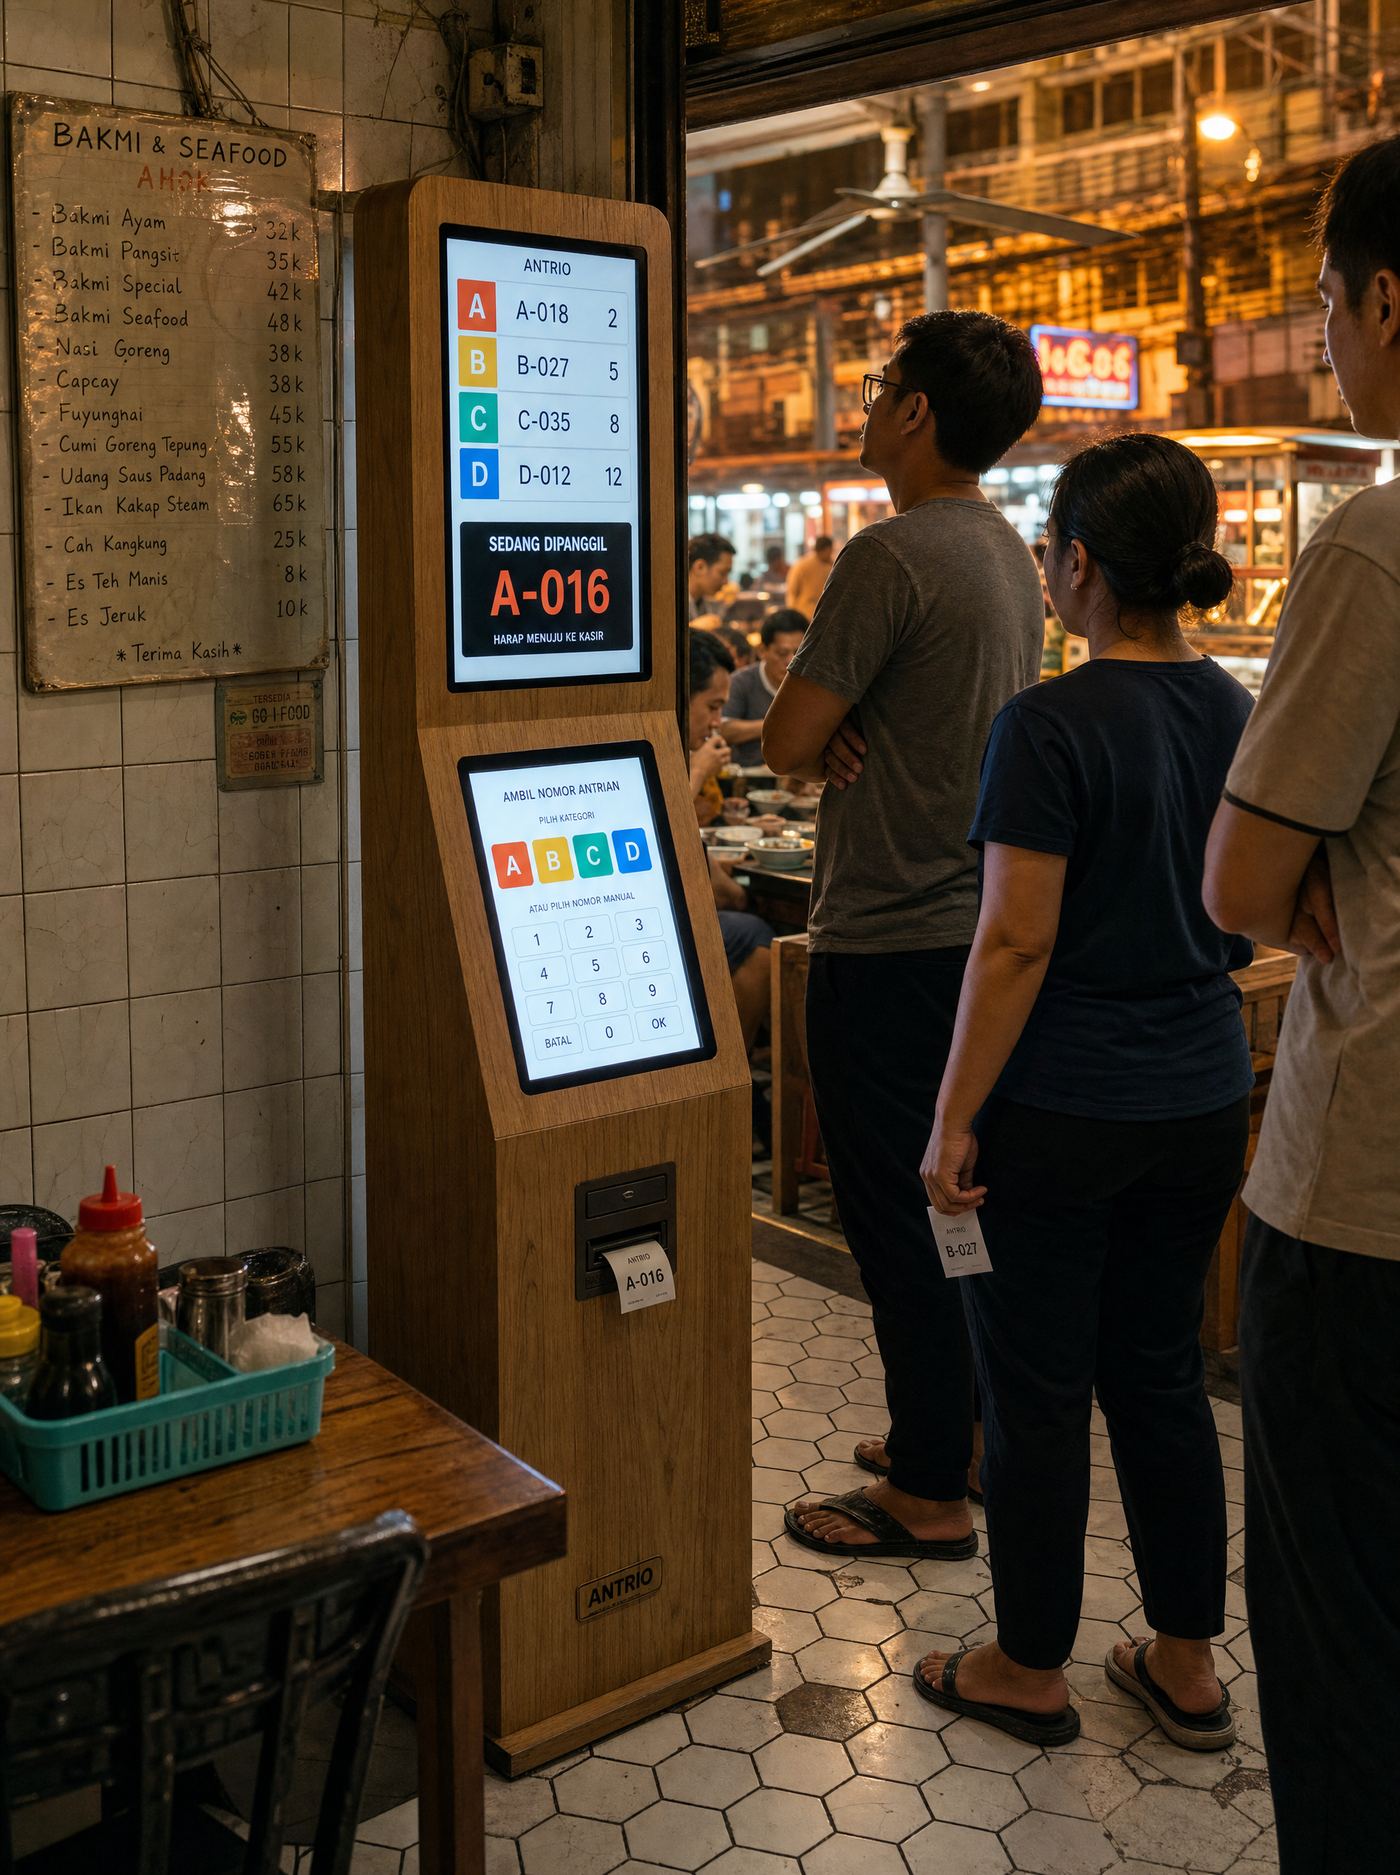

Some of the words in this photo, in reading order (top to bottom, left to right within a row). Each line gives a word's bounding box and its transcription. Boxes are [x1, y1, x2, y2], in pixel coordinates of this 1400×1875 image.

[53, 122, 141, 154] BAKMI
[152, 135, 166, 154] &
[179, 136, 287, 167] SEAFOOD
[137, 165, 213, 193] AHOK
[51, 203, 110, 227] Bakmi
[121, 208, 166, 235] Ayam
[51, 236, 110, 258] Bakmi
[121, 240, 181, 268] Pangsit
[266, 251, 301, 272] 35k
[524, 258, 571, 276] ANTRIO
[52, 270, 110, 292] Bakmi
[122, 275, 183, 299] Special
[267, 281, 302, 301] 42k
[53, 303, 110, 324] Bakmi
[122, 307, 189, 327] Seafood
[267, 313, 303, 333] 48k
[468, 293, 486, 320] A
[516, 300, 569, 324] A-018
[608, 308, 618, 328] 2
[55, 337, 98, 357] Nasi
[114, 339, 170, 365] Goreng
[268, 344, 304, 363] 38k
[470, 349, 486, 375] B
[517, 354, 569, 378] B-027
[609, 361, 619, 381] 5
[56, 370, 119, 396] Capcay
[269, 374, 304, 394] 38k
[269, 405, 305, 424] 45k
[470, 405, 487, 431] C
[518, 409, 571, 432] C-035
[610, 414, 620, 434] 8
[59, 435, 97, 453] Cumi
[105, 435, 156, 459] Goreng
[162, 436, 207, 458] Tepung
[271, 435, 305, 454] 55k
[61, 468, 109, 490] Udang
[118, 467, 152, 483] Saus
[160, 467, 206, 489] Padang
[272, 466, 306, 483] 58k
[471, 461, 488, 487] D
[519, 464, 571, 486] D-012
[605, 466, 622, 487] 12
[62, 497, 103, 516] Ikan
[117, 497, 160, 518] Kakap
[167, 496, 209, 512] Steam
[273, 494, 306, 512] 65k
[64, 535, 93, 553] Cah
[104, 535, 167, 556] Kangkung
[273, 530, 307, 549] 25k
[489, 536, 540, 552] SEDANG
[544, 536, 608, 552] DIPANGGIL
[66, 574, 85, 591] Es
[93, 572, 119, 589] Teh
[129, 571, 168, 588] Manis
[490, 568, 610, 616] A-016
[68, 608, 89, 627] Es
[101, 606, 146, 627] Jeruk
[493, 634, 524, 645] HARAP
[526, 632, 563, 644] MENUJU
[565, 631, 576, 642] KE
[579, 631, 604, 641] KASIR
[253, 693, 291, 704] TERSEDIA
[503, 789, 536, 802] AMBIL
[538, 785, 576, 799] NOMOR
[578, 781, 620, 795] ANTRIAN
[539, 815, 558, 825] PILIH
[560, 811, 595, 823] KATEGORI
[506, 855, 522, 876] A
[546, 850, 561, 871] B
[586, 845, 601, 866] C
[625, 841, 640, 861] D
[529, 904, 549, 914] ATAU
[551, 901, 571, 911] PILIH
[572, 897, 602, 908] NOMOR
[603, 892, 635, 903] MANUAL
[533, 933, 541, 946] 1
[585, 925, 594, 939] 2
[635, 918, 644, 931] 3
[540, 967, 548, 980] 4
[591, 958, 600, 972] 5
[642, 951, 650, 964] 6
[546, 1001, 554, 1014] 7
[599, 992, 607, 1005] 8
[648, 983, 657, 997] 9
[544, 1035, 572, 1049] BATAL
[605, 1025, 614, 1039] 0
[651, 1017, 667, 1030] OK
[627, 1253, 651, 1265] ANTRIO
[945, 1242, 977, 1258] B-027
[626, 1268, 664, 1291] A-016
[588, 1567, 653, 1608] ANTRIO
